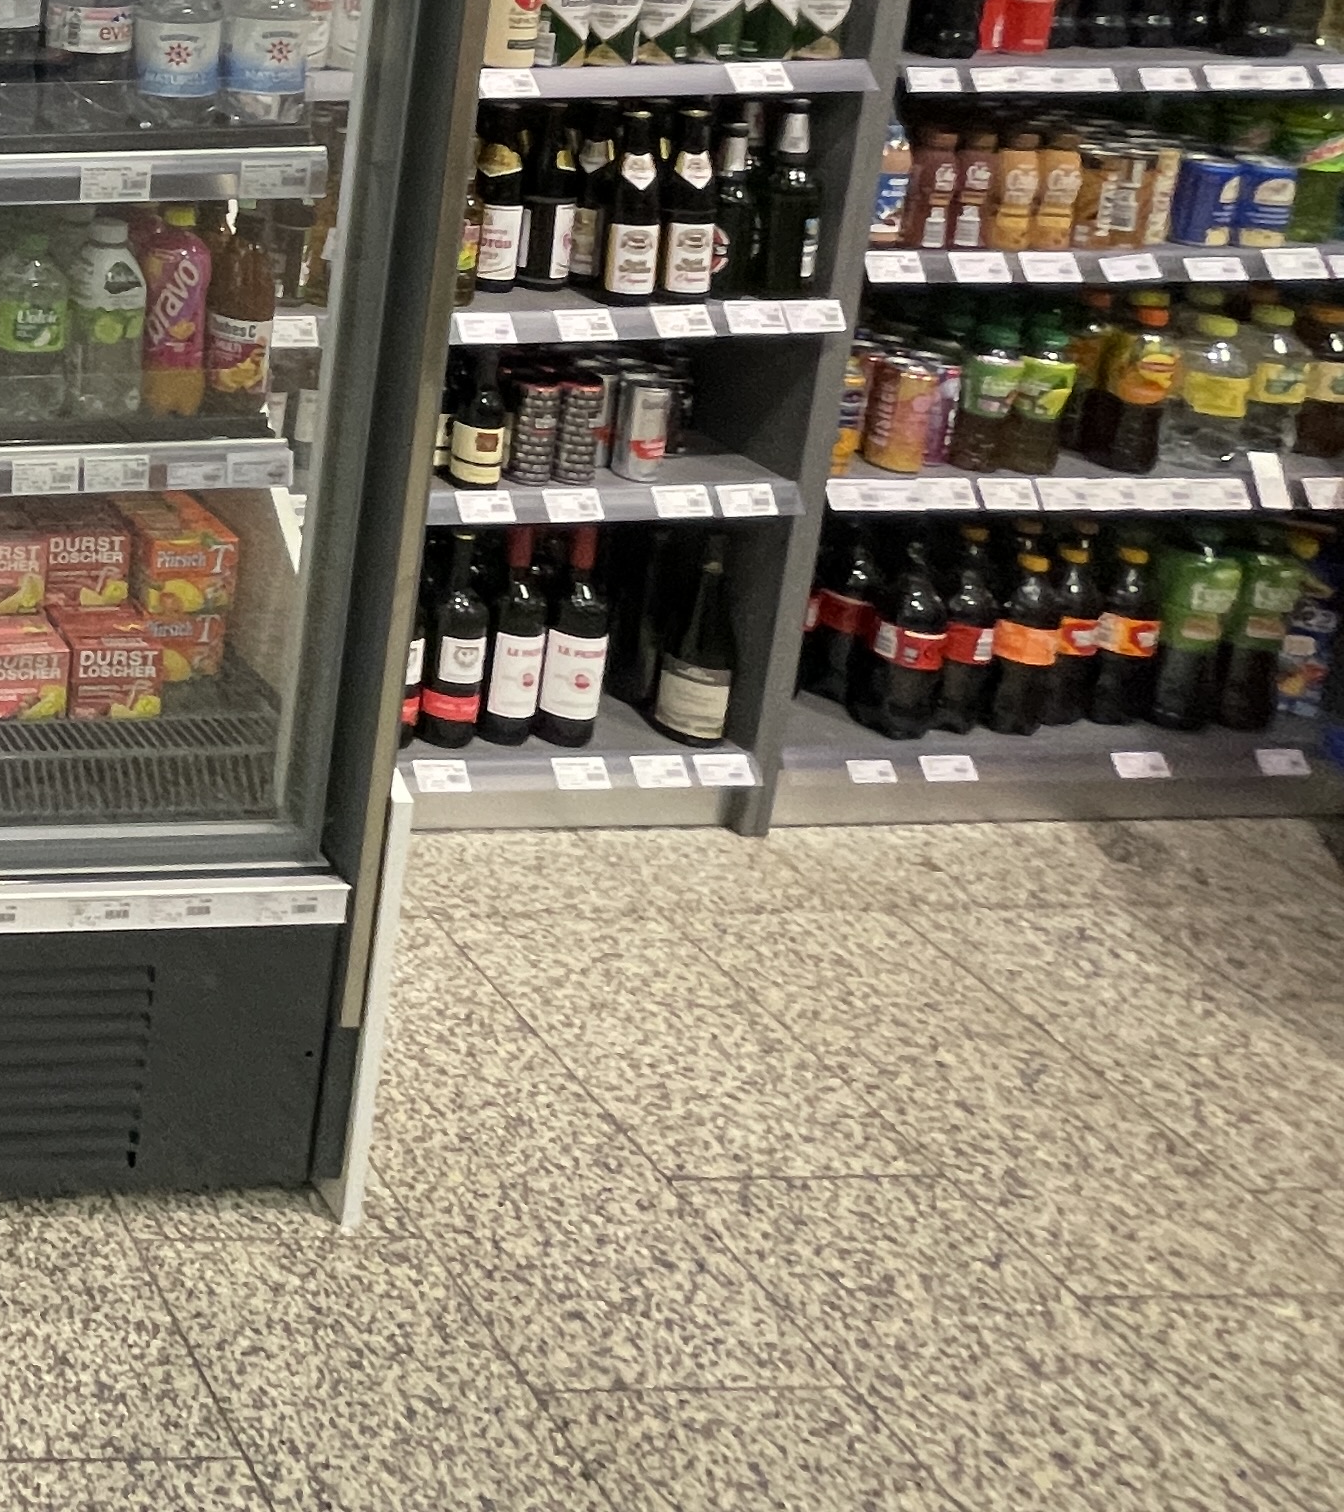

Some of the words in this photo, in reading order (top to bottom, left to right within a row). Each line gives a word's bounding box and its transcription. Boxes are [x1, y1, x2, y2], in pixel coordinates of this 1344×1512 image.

[49, 536, 126, 552] DURST
[210, 544, 234, 574] T
[79, 650, 159, 666] DURST
